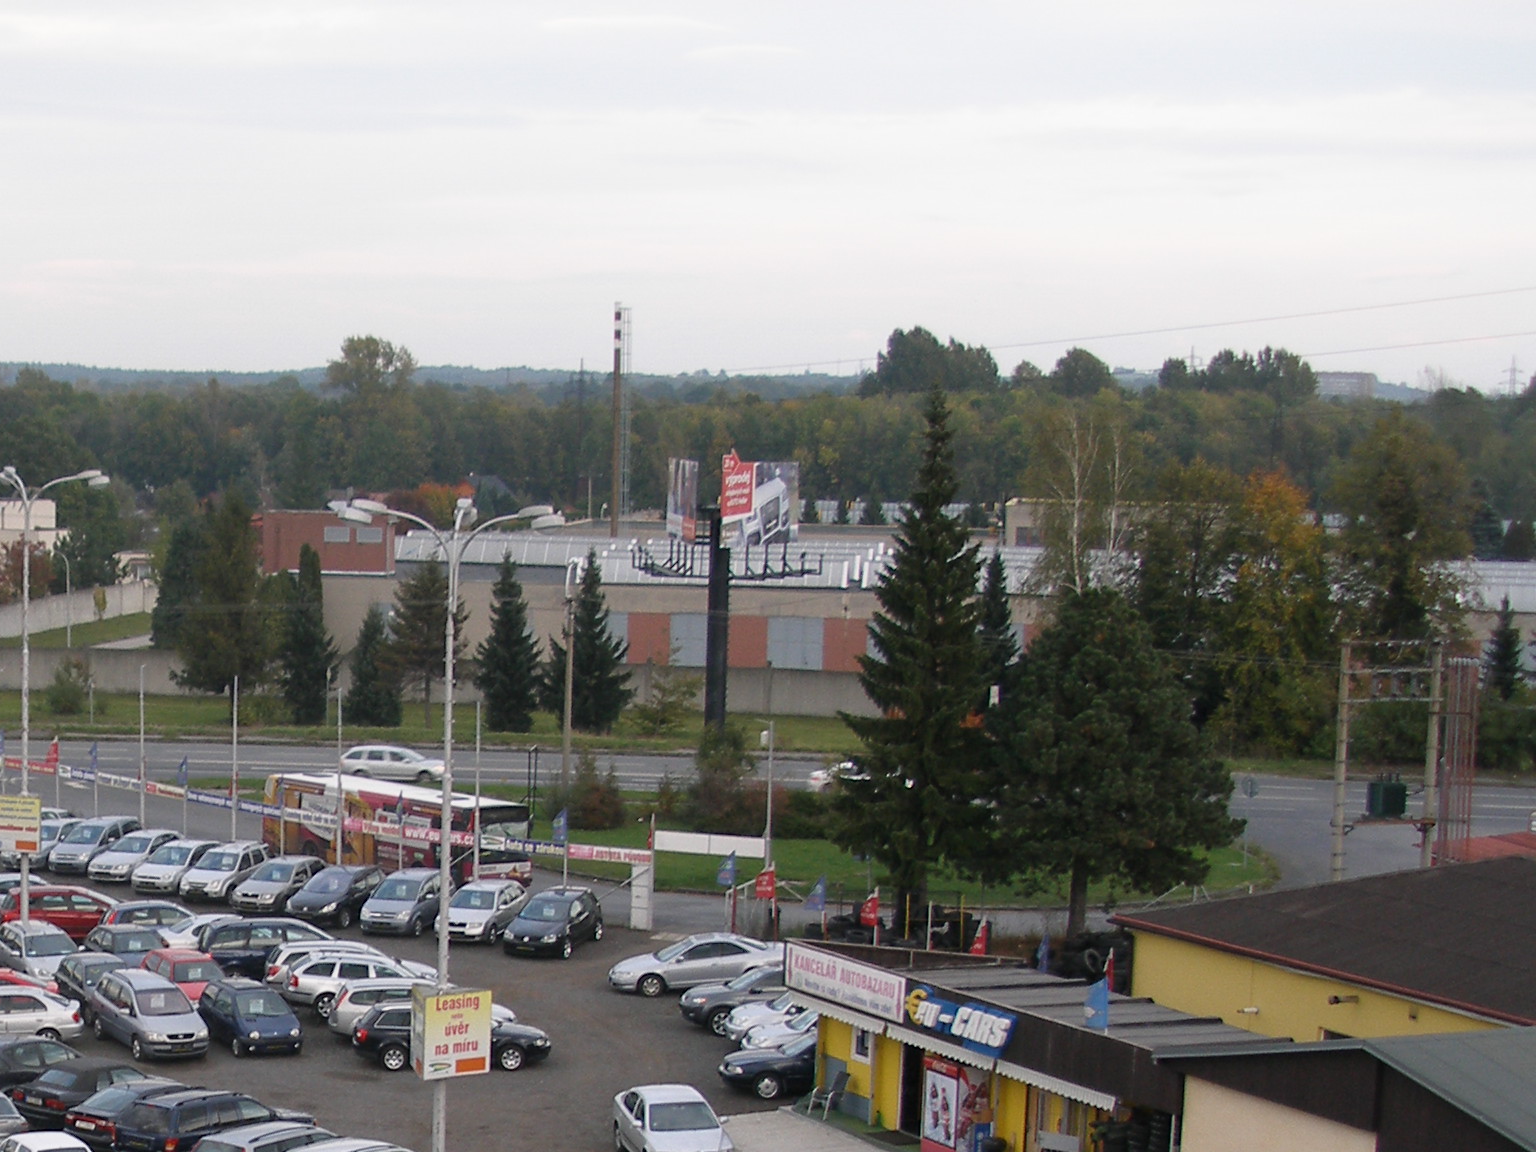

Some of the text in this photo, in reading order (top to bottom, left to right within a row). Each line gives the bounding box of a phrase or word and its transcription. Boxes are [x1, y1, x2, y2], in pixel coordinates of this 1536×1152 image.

[794, 953, 896, 999] KANCELÁŘ AUTOBAZARU
[436, 993, 481, 1011] Leasing
[444, 1022, 470, 1037] úvěr
[434, 1038, 479, 1056] na míru
